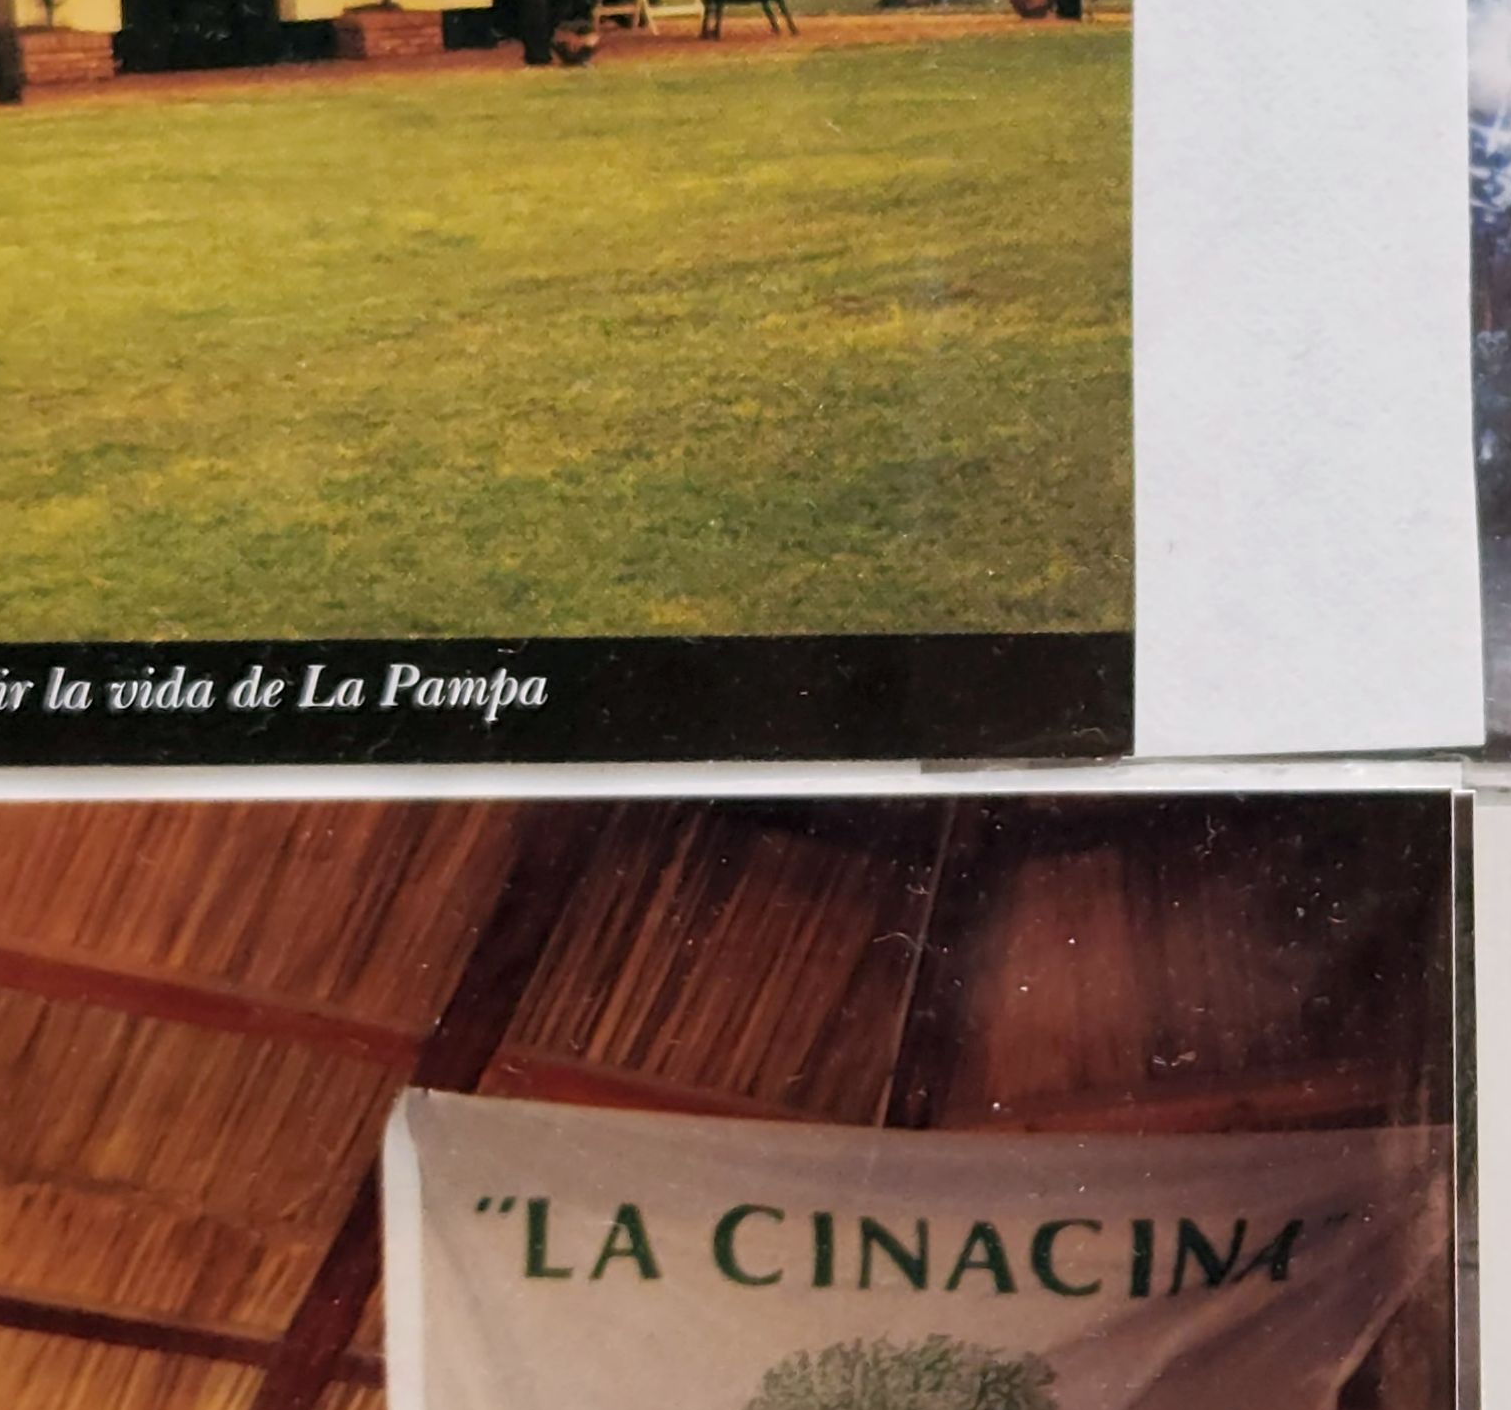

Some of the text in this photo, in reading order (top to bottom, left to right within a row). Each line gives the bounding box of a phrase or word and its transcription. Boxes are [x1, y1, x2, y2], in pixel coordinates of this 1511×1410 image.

[47, 667, 92, 709] la
[111, 666, 214, 708] vida
[232, 666, 284, 707] de
[299, 665, 364, 707] La
[380, 664, 547, 723] Pampa
